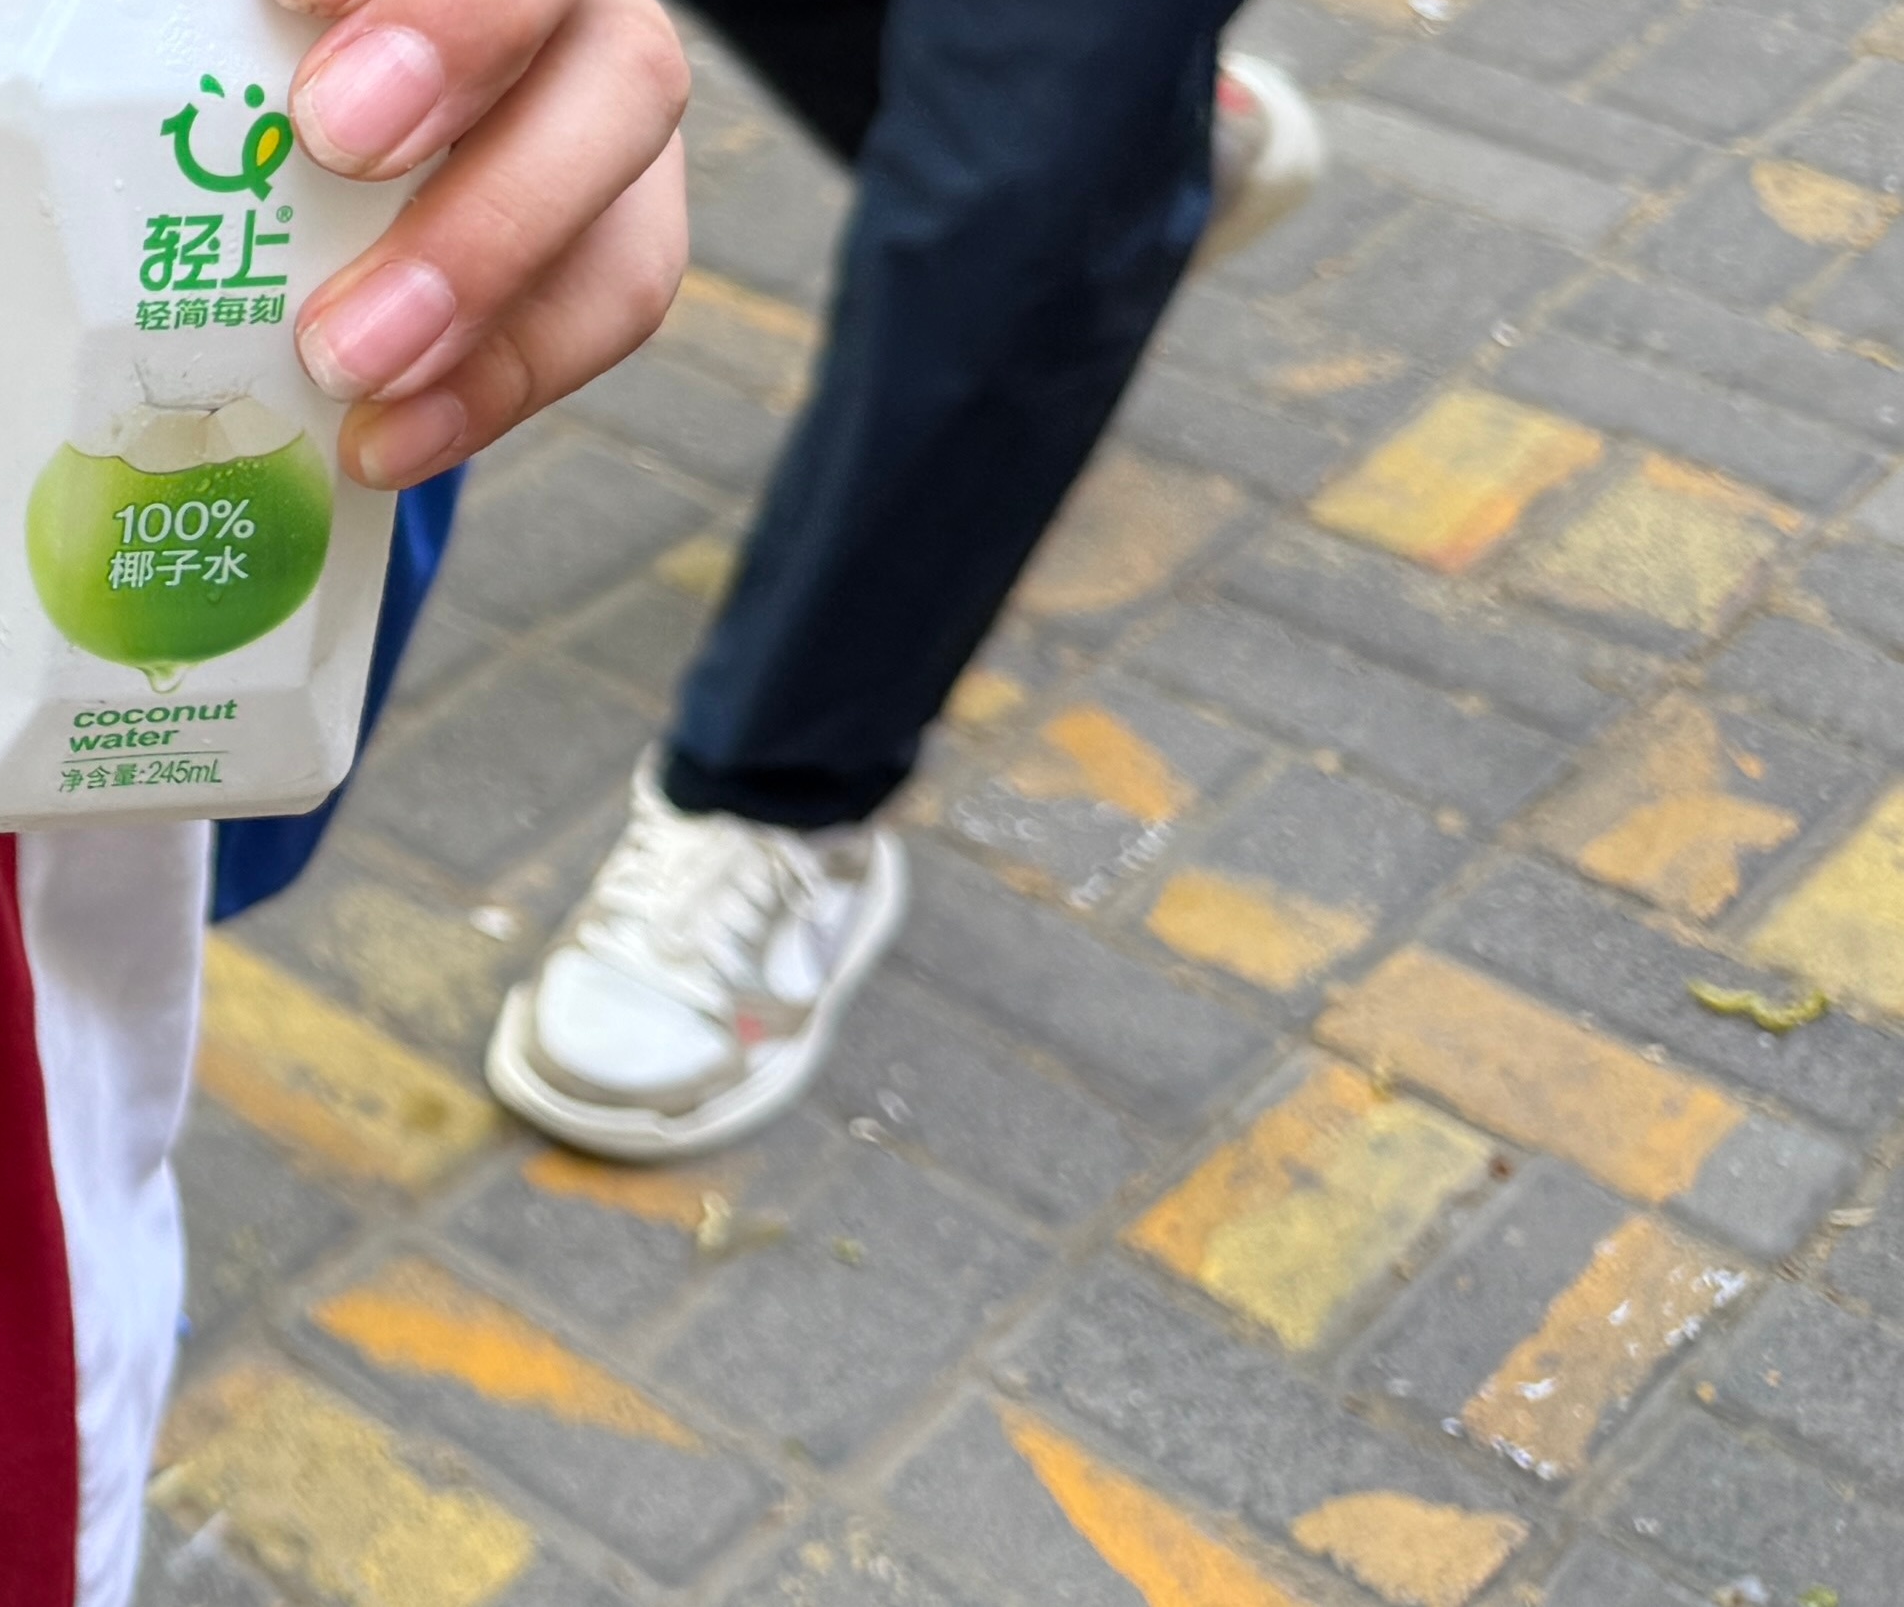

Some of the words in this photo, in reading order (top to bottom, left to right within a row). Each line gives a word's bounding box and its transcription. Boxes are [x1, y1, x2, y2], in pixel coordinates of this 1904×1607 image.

[139, 209, 291, 292] 轻上
[134, 293, 286, 331] 轻简每刻
[114, 499, 256, 544] 100%
[108, 545, 249, 590] 椰子水
[73, 698, 238, 729] coconut
[69, 727, 181, 754] water
